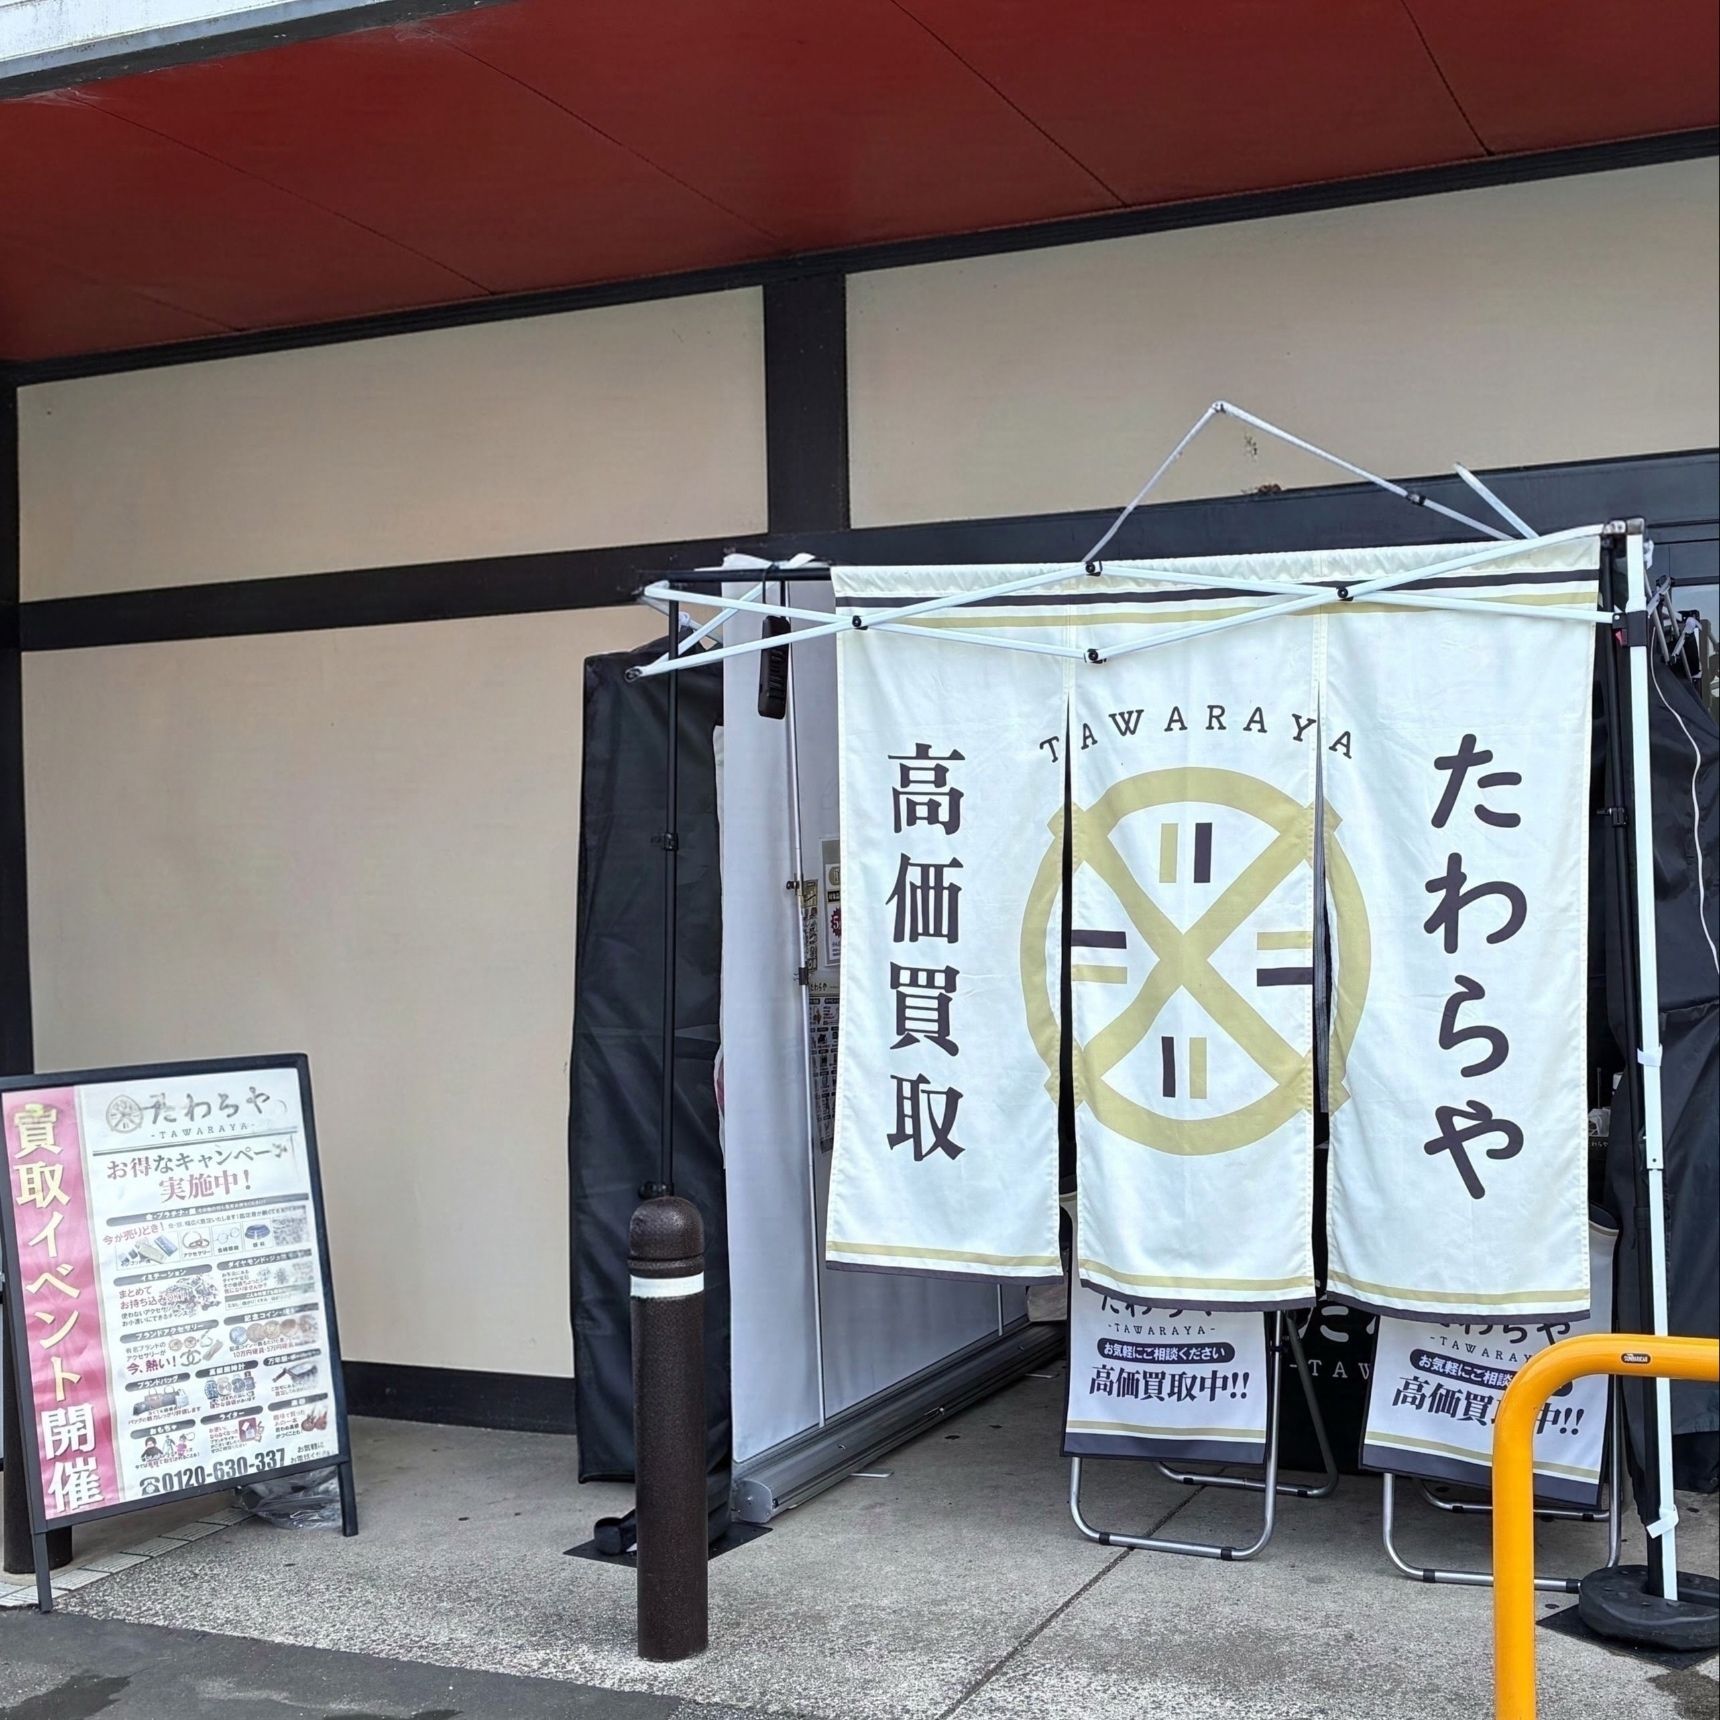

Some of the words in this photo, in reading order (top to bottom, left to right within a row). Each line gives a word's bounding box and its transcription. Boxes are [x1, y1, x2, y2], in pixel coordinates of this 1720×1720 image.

[1039, 704, 1354, 763] TAWARAYA
[886, 742, 966, 1162] 高価買取
[1424, 733, 1528, 1199] たわらや
[1103, 1342, 1226, 1361] お気軽にご相談ください
[162, 1447, 286, 1491] 0120-630-337
